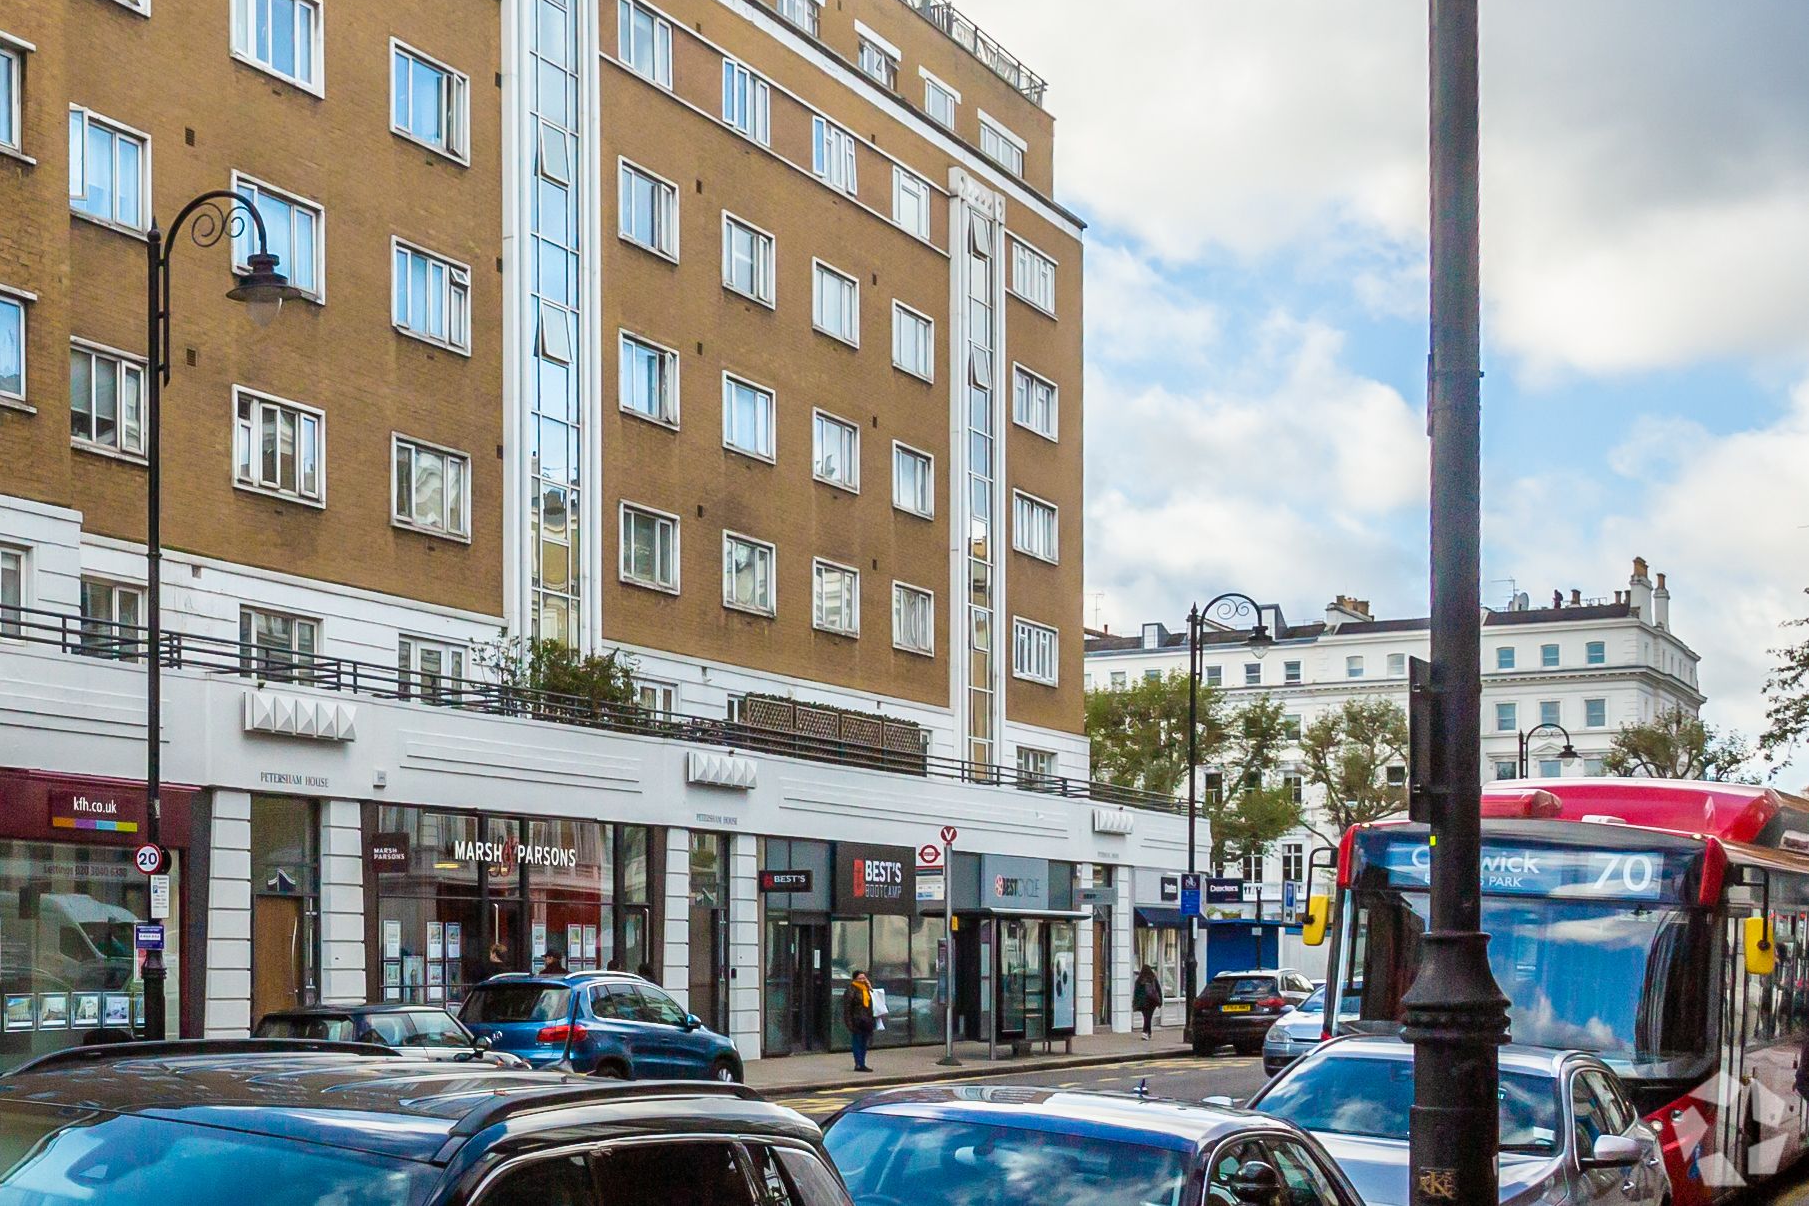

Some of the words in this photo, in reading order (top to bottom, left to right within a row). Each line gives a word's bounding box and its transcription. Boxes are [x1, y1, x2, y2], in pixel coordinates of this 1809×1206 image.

[260, 771, 302, 785] PETERSHAM
[305, 776, 329, 788] HOUSE
[73, 796, 117, 814] kfh.co.uk
[943, 829, 955, 841] V
[139, 852, 158, 865] 20
[455, 840, 502, 863] MARSH
[517, 845, 576, 867] PARSONS
[774, 875, 806, 883] BEST'S
[865, 860, 902, 883] BEST'S
[1594, 853, 1653, 892] 70
[1489, 876, 1523, 887] PARK
[865, 884, 902, 899] BOOTCAMP
